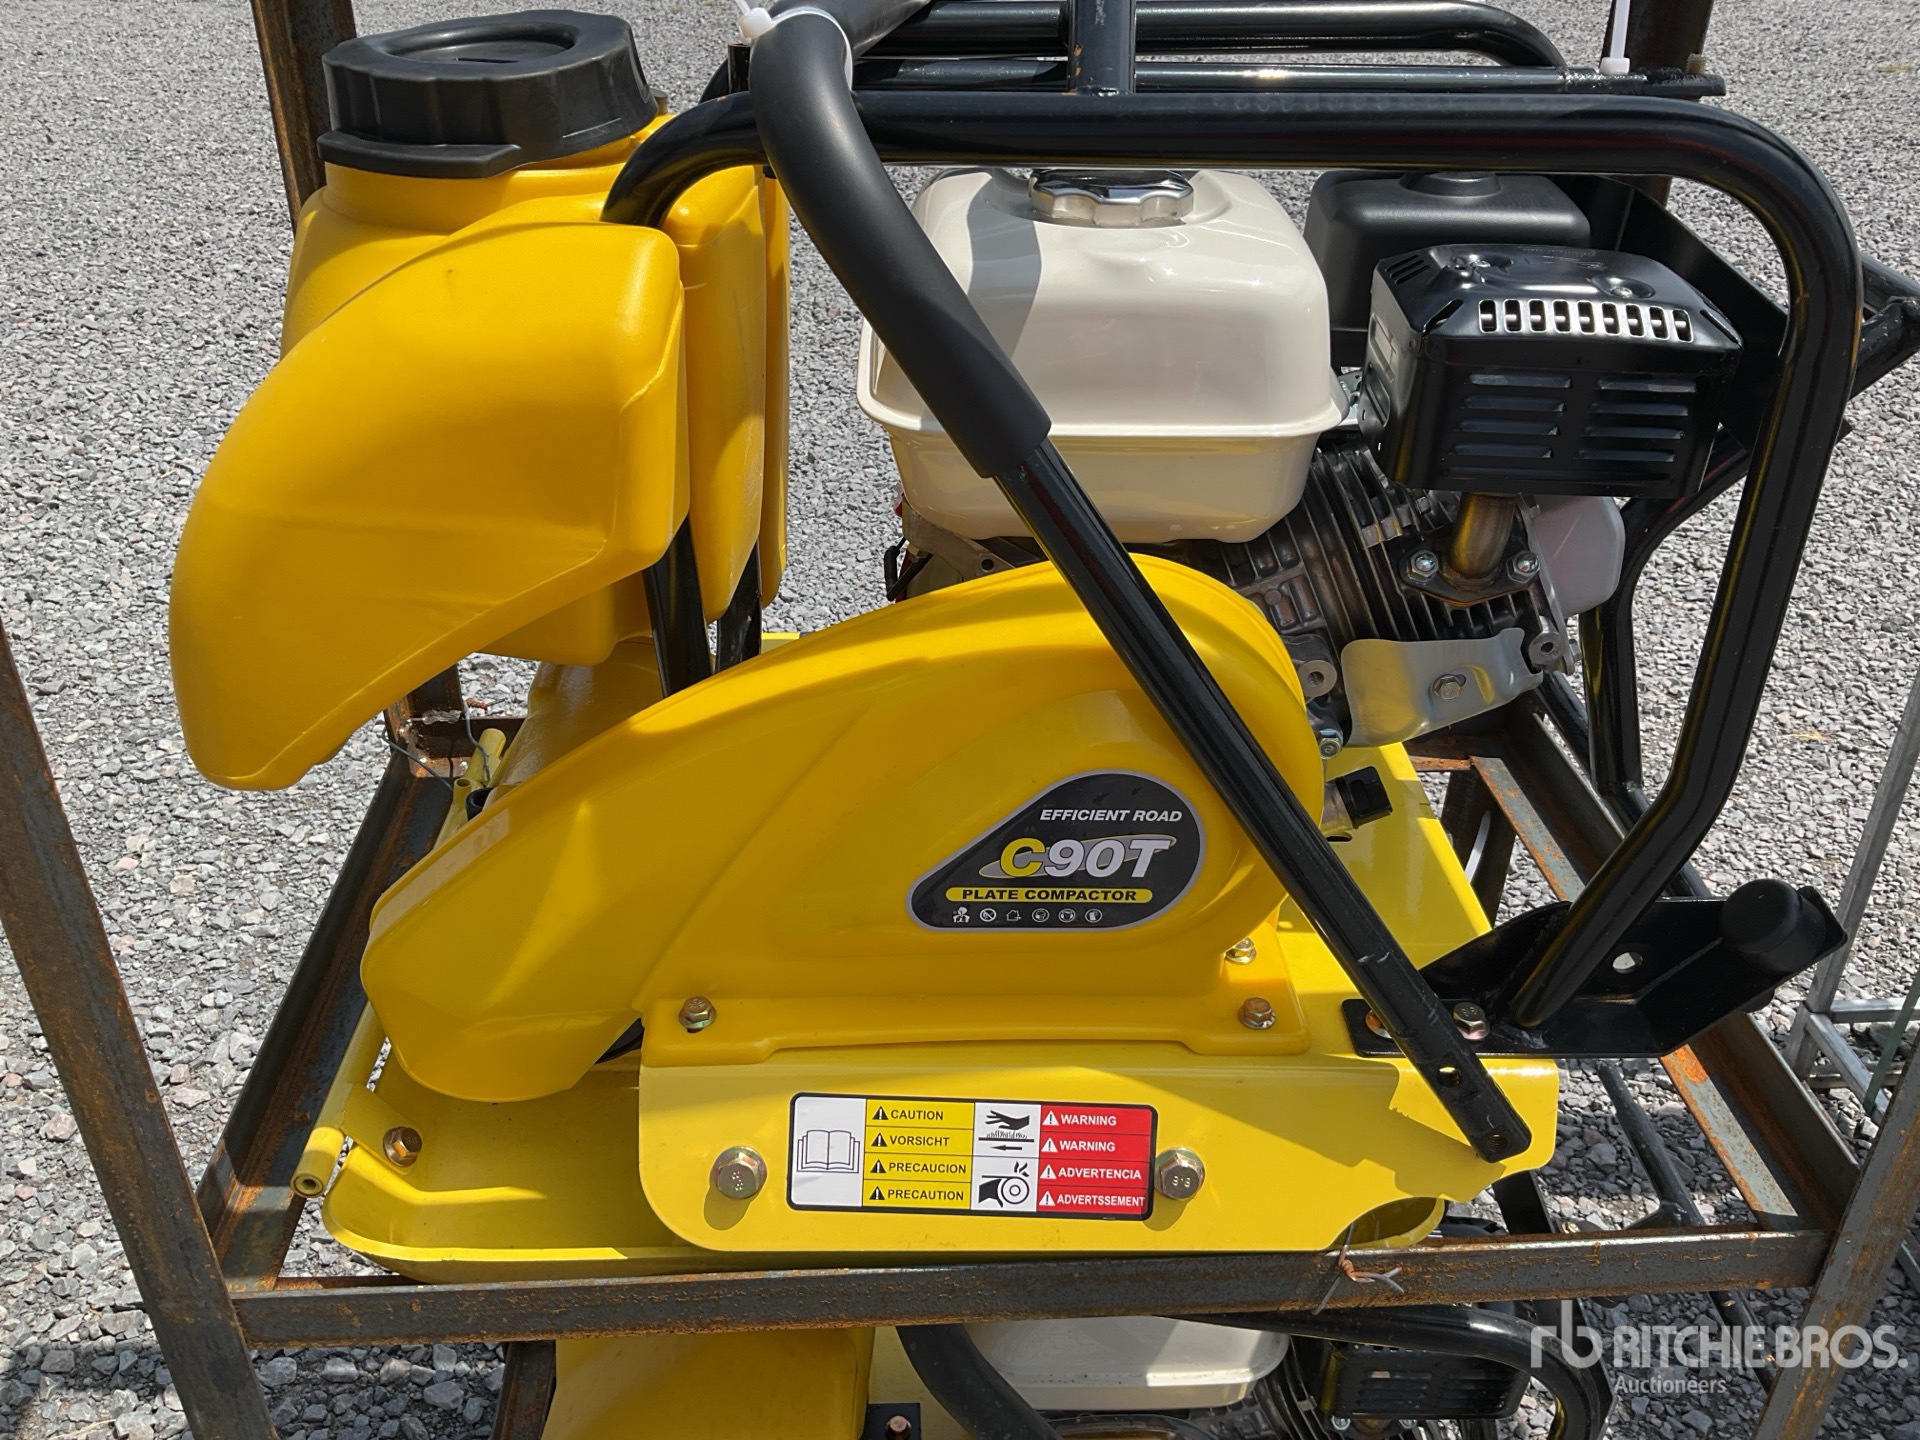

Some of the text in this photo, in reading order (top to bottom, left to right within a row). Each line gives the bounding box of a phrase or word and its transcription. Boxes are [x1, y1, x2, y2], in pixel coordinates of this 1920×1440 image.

[1039, 809, 1183, 823] EFFICIENT ROAD
[1000, 837, 1171, 878] C90T
[961, 888, 1137, 901] PLATE COMPACTOR
[890, 1109, 944, 1121] CAUTION
[1060, 1114, 1117, 1126] WARNING
[889, 1135, 950, 1147] VORSICHT
[1059, 1140, 1116, 1152] WARNING
[888, 1162, 967, 1174] PRECAUCION
[1057, 1167, 1142, 1180] ADVERTENCIA
[887, 1189, 964, 1201] PRECAUTION
[1056, 1194, 1146, 1207] ADVERTSSEMENT
